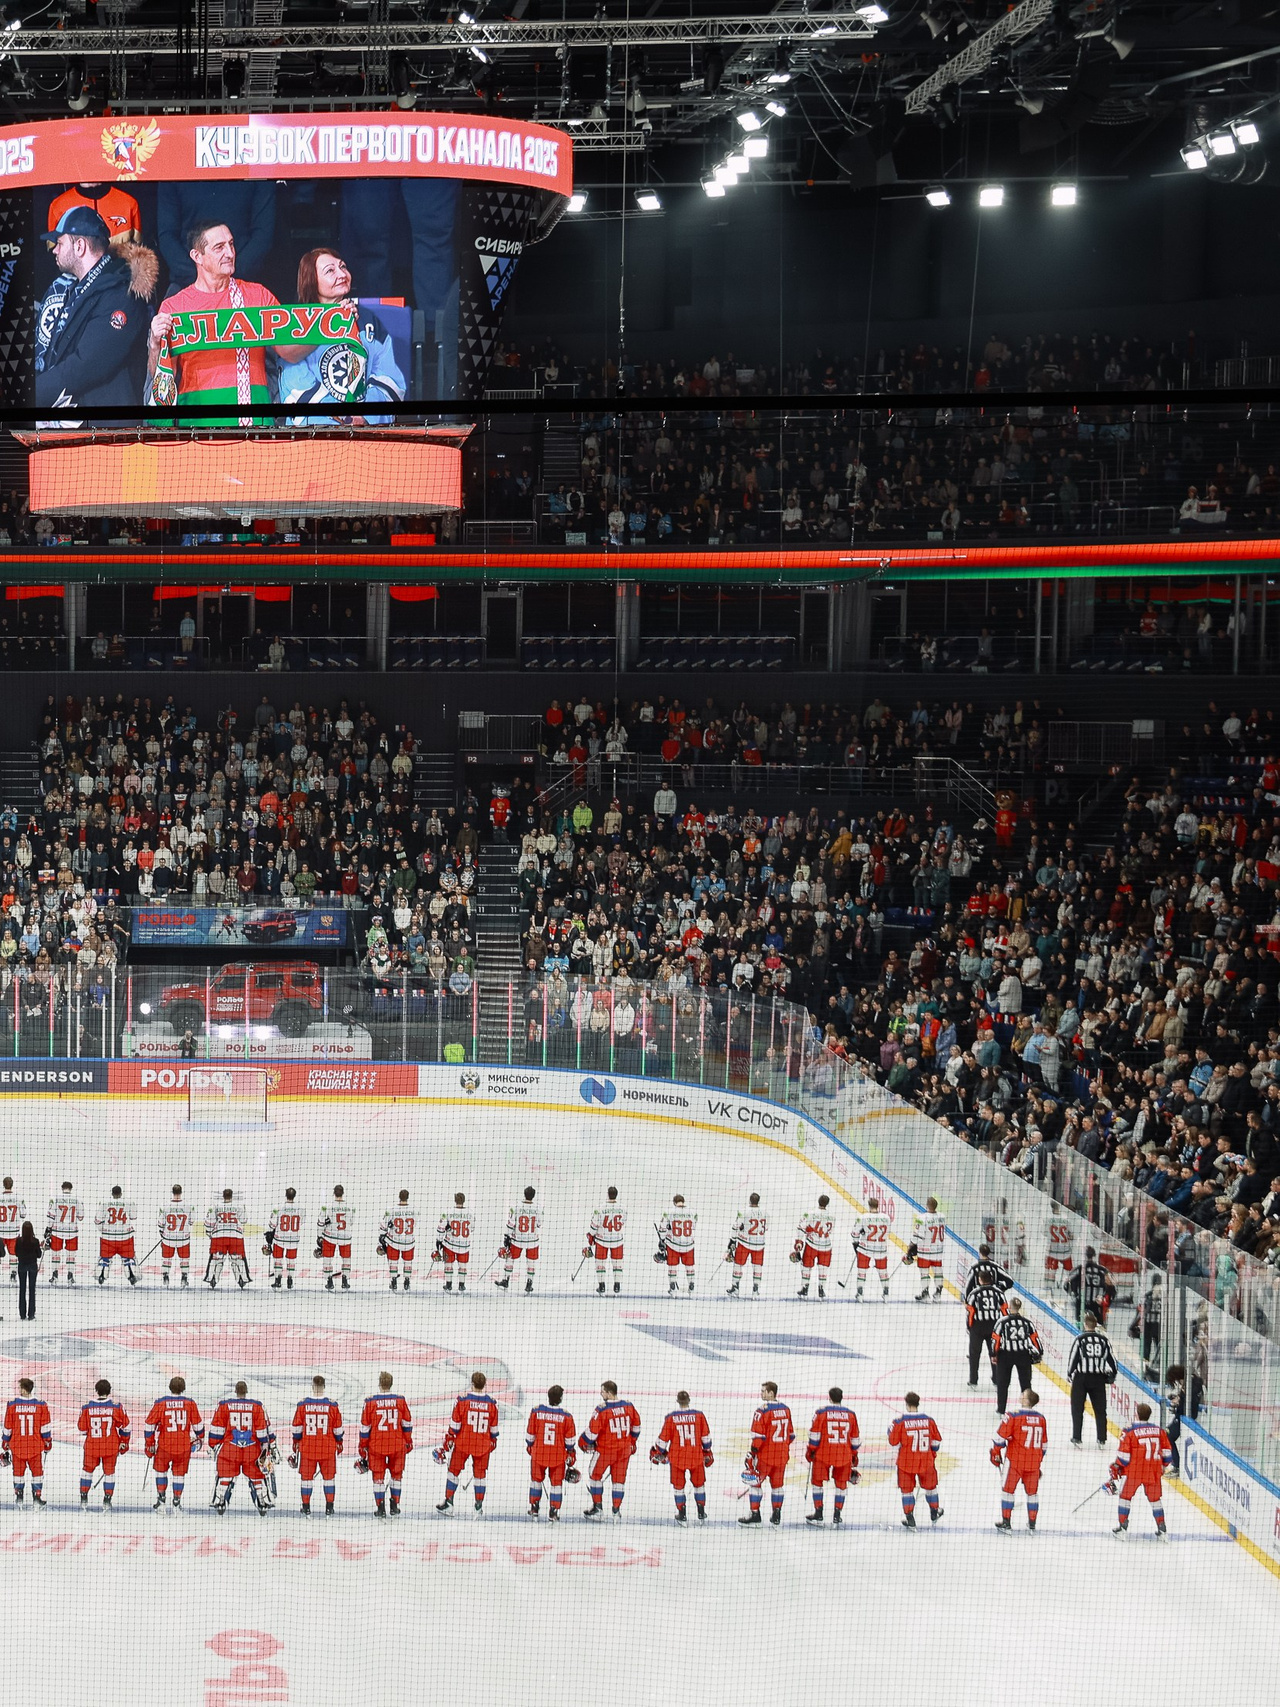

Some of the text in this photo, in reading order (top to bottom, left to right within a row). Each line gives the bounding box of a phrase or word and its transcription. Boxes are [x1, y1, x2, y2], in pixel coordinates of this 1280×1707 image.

[318, 125, 434, 164] ПЕРВОГО
[437, 127, 522, 171] КАНАЛА
[524, 137, 559, 178] 2025
[138, 912, 196, 926] РОЛЬФ
[140, 1068, 233, 1089] РОЛЬФ
[306, 1079, 352, 1090] МАШИНА
[308, 1070, 353, 1080] КРАСНАЯ
[487, 1074, 540, 1085] МИНСПОРТ
[487, 1085, 528, 1095] РОССИИ
[623, 1089, 689, 1108] НОРНИКЕЛЬ
[707, 1099, 789, 1134] VK СПОРТ
[57, 1205, 76, 1223] 71
[107, 1206, 128, 1225] 34
[166, 1213, 188, 1232] 97
[279, 1214, 301, 1232] 80
[335, 1213, 347, 1231] 5
[602, 1215, 623, 1232] 46
[393, 1217, 415, 1235] 93
[450, 1219, 470, 1238] 96
[518, 1215, 536, 1233] 81
[671, 1219, 693, 1237] 68
[747, 1218, 767, 1236] 23
[814, 1220, 833, 1238] 42
[866, 1224, 888, 1243] 22
[928, 1225, 945, 1244] 70
[982, 1297, 995, 1310] 31
[1009, 1326, 1026, 1340] 24
[1085, 1343, 1102, 1357] 98
[19, 1415, 34, 1436] 11
[90, 1415, 113, 1438] 87
[164, 1409, 187, 1432] 34
[229, 1412, 253, 1431] 99
[305, 1414, 328, 1436] 89
[376, 1409, 399, 1431] 24
[467, 1410, 489, 1433] 96
[608, 1416, 631, 1439] 44
[543, 1422, 556, 1446] 6
[676, 1424, 696, 1448] 14
[771, 1418, 790, 1443] 27
[827, 1421, 850, 1444] 53
[1021, 1425, 1043, 1449] 70
[906, 1429, 931, 1452] 76
[1138, 1437, 1161, 1460] 72
